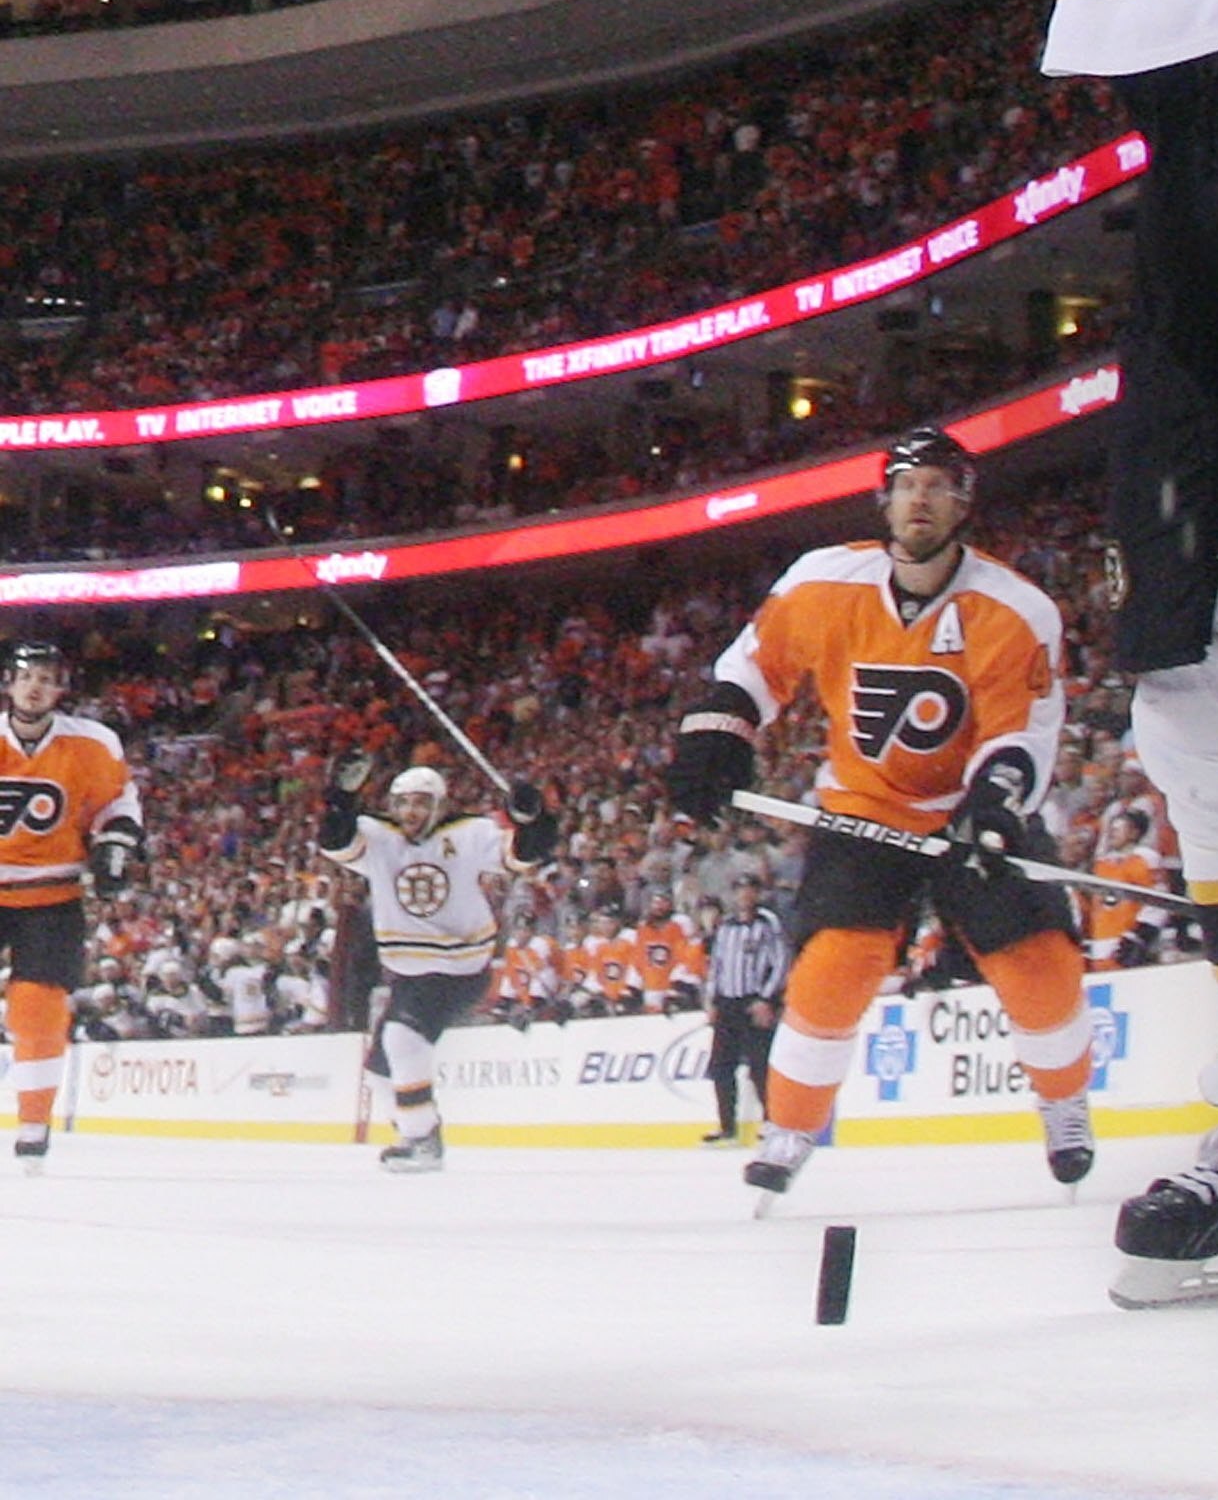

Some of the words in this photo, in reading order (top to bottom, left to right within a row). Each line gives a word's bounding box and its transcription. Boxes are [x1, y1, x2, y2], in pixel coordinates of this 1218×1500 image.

[522, 355, 566, 382] THE
[565, 336, 651, 375] XFINITY
[795, 283, 824, 312] TV
[831, 245, 924, 301] INTERNET
[39, 419, 105, 444] PLAY.
[136, 413, 166, 437] TV
[176, 399, 282, 433] INTERNET
[292, 391, 358, 420] VOICE
[930, 601, 966, 654] A
[120, 1058, 199, 1095] TOYOTA
[456, 1056, 562, 1090] AIRWAYS
[578, 1050, 656, 1085] BUD
